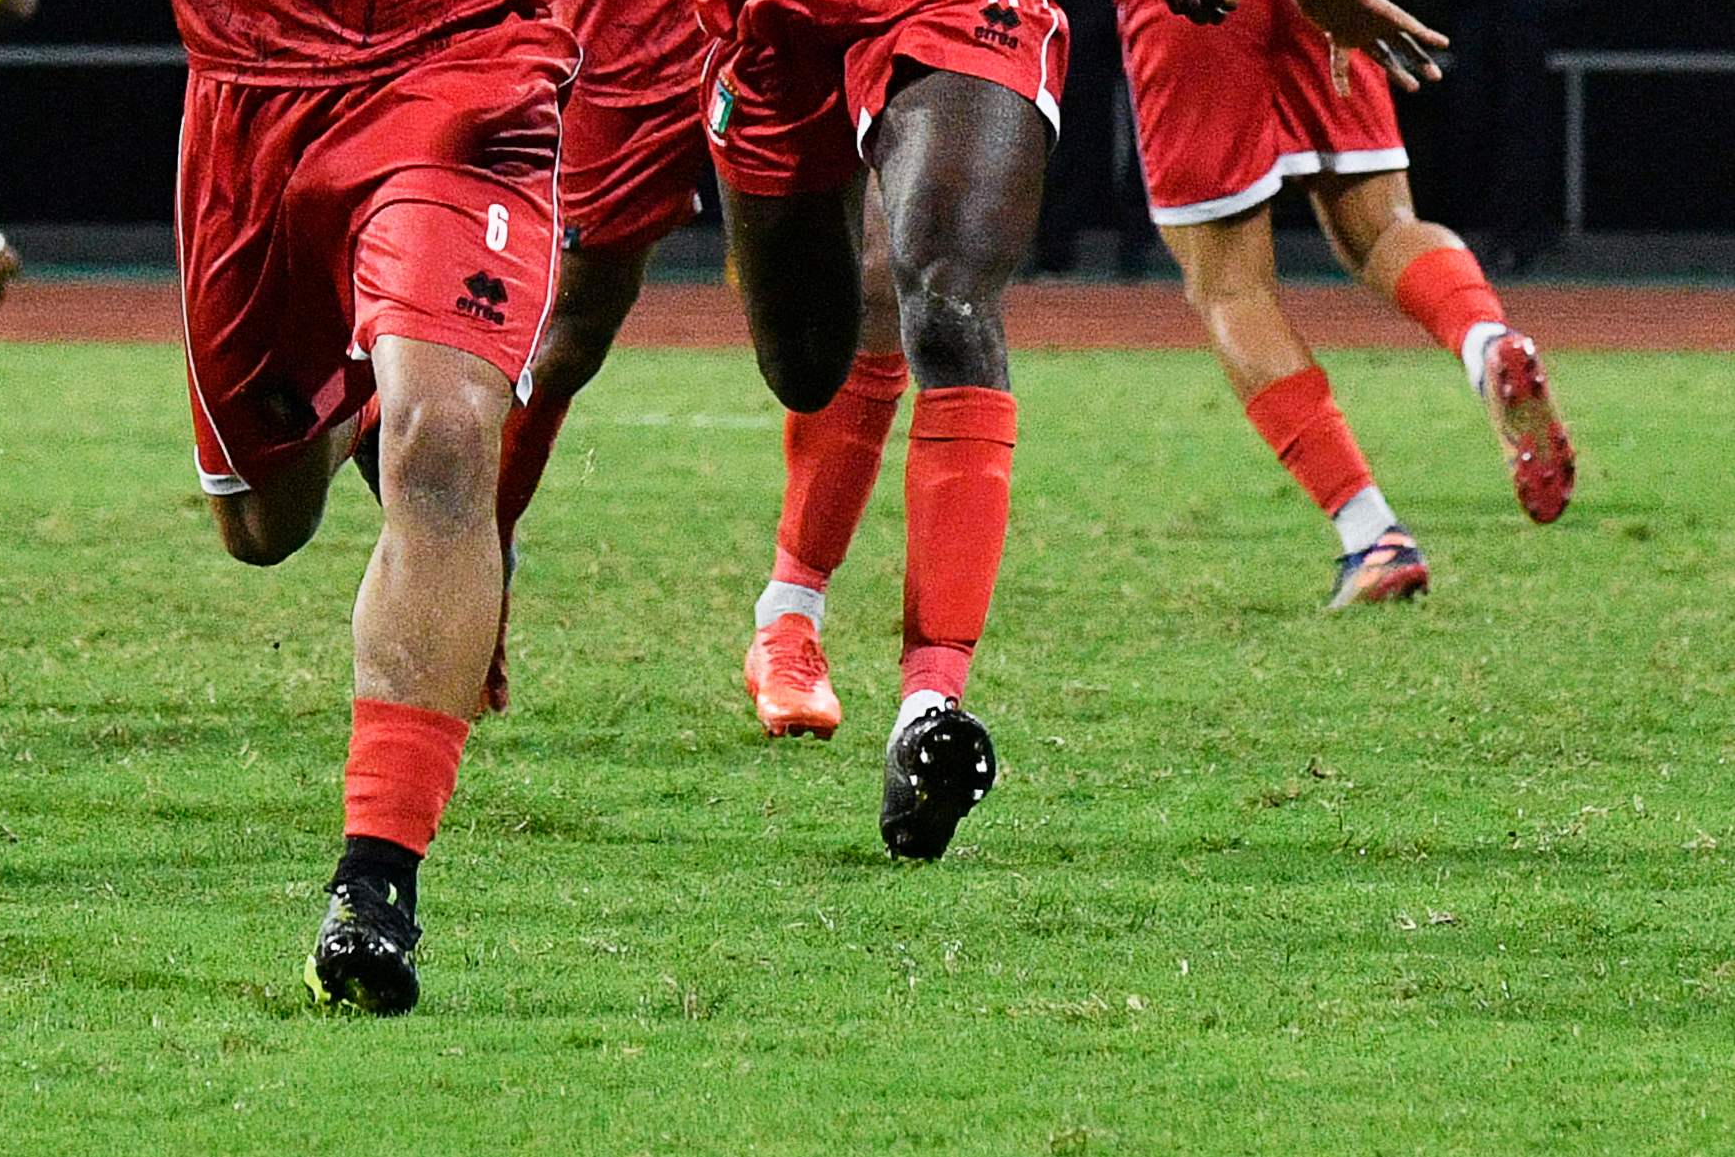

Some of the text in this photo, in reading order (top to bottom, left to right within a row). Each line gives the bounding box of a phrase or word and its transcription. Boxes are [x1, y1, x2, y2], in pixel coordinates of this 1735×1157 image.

[974, 26, 1019, 50] errea
[485, 203, 509, 252] 6
[456, 296, 506, 326] errea
